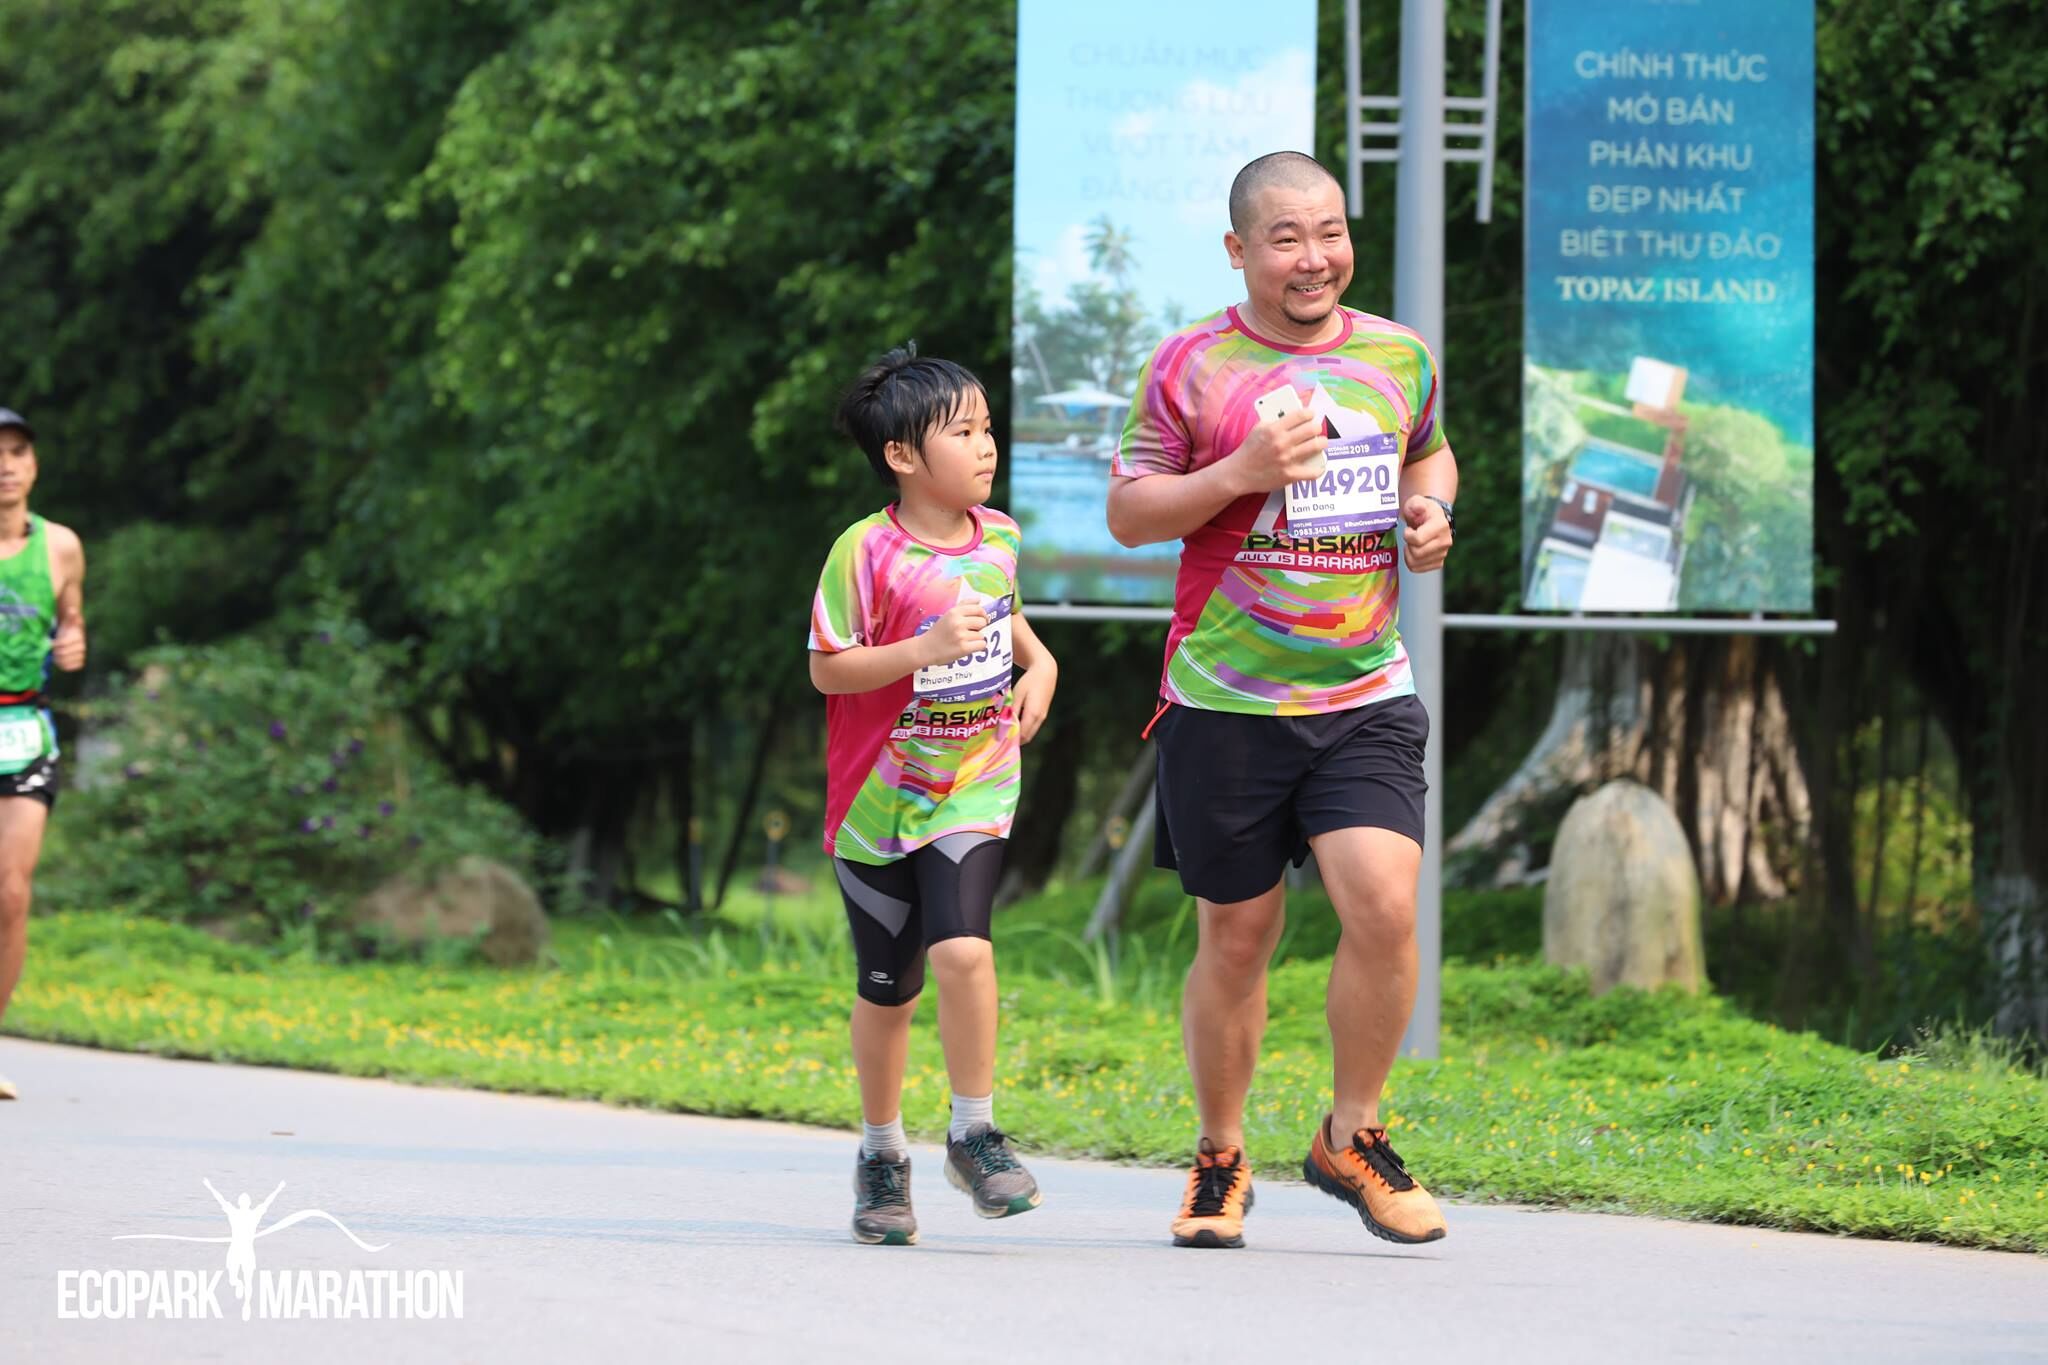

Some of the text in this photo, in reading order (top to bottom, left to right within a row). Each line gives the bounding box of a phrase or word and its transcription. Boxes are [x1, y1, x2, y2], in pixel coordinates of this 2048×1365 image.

[1575, 47, 1768, 82] CHÍNH THỨC
[1665, 93, 1734, 125] BÁN
[1685, 143, 1752, 171] KHU
[1556, 275, 1776, 305] TOPAZ ISLAND
[1350, 444, 1370, 455] 2019
[1292, 464, 1390, 500] M4920
[1292, 505, 1311, 513] Lam
[1240, 553, 1272, 562] JULY
